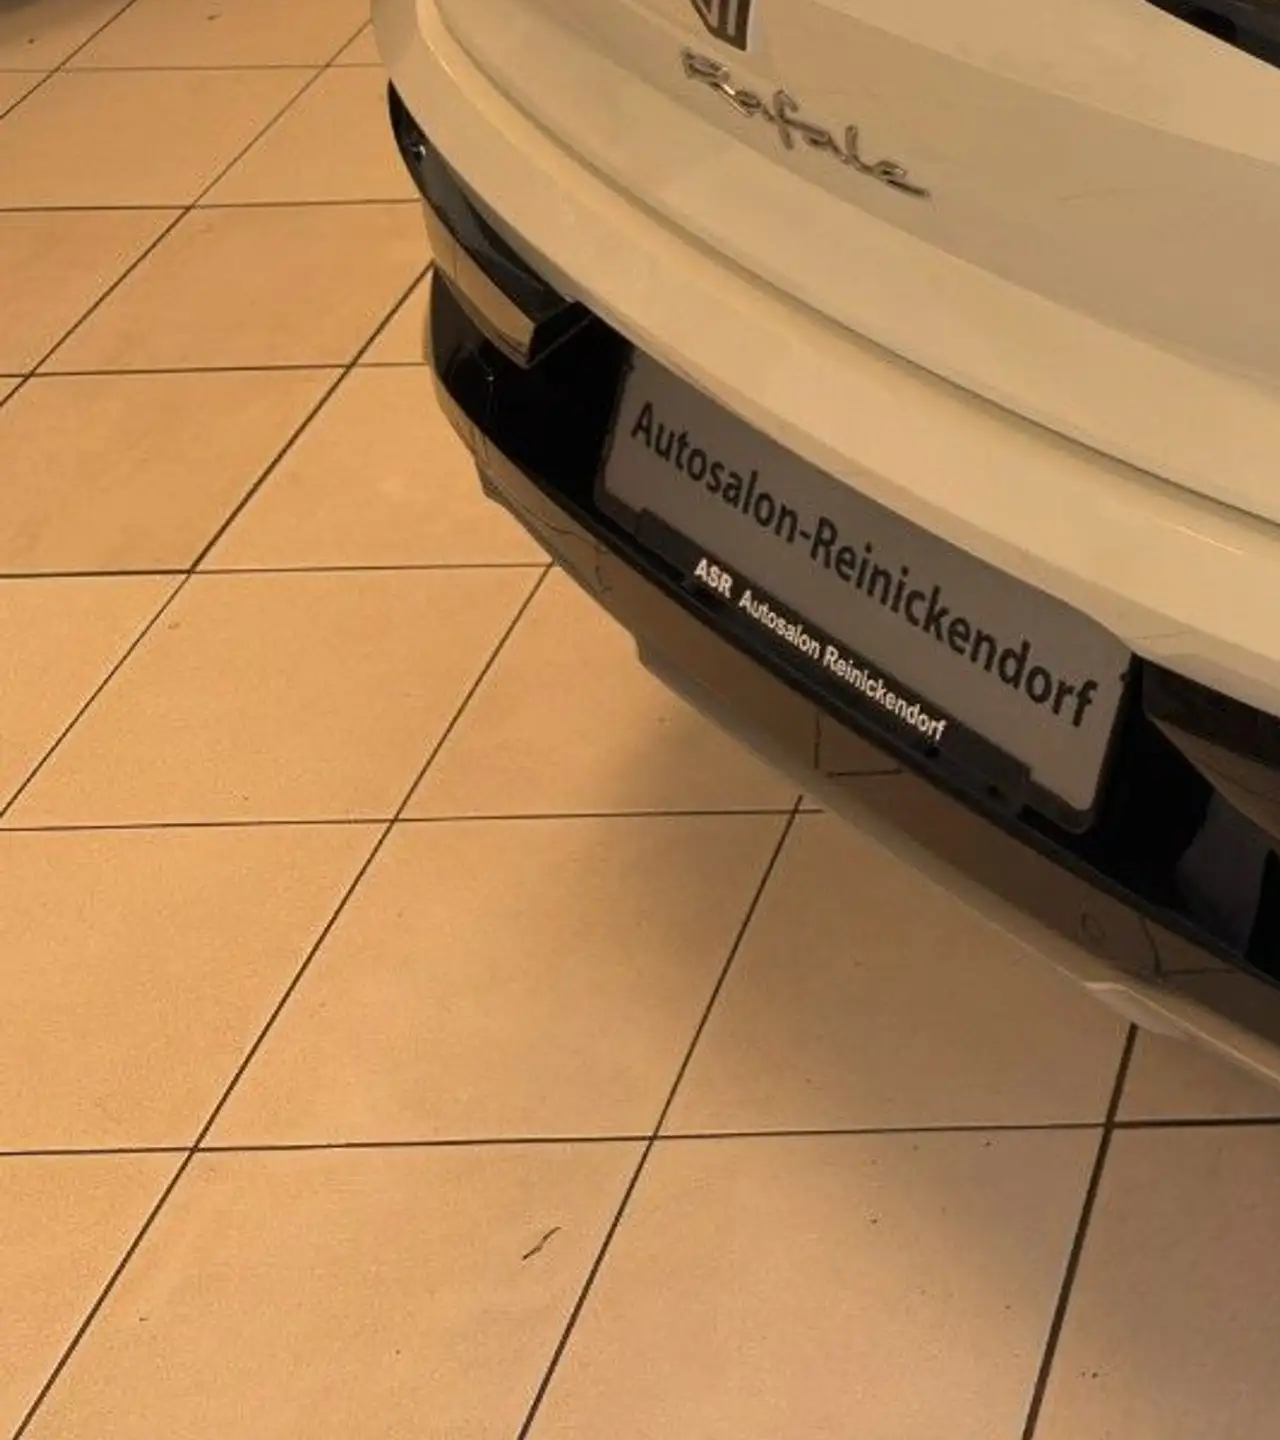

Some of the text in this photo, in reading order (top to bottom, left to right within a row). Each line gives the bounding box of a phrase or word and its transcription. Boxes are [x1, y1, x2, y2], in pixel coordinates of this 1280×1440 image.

[681, 46, 932, 198] Rafale
[630, 401, 1098, 728] Autosalon-Reinickendorf
[694, 558, 947, 741] ASR Autosalon Reinickendorf
